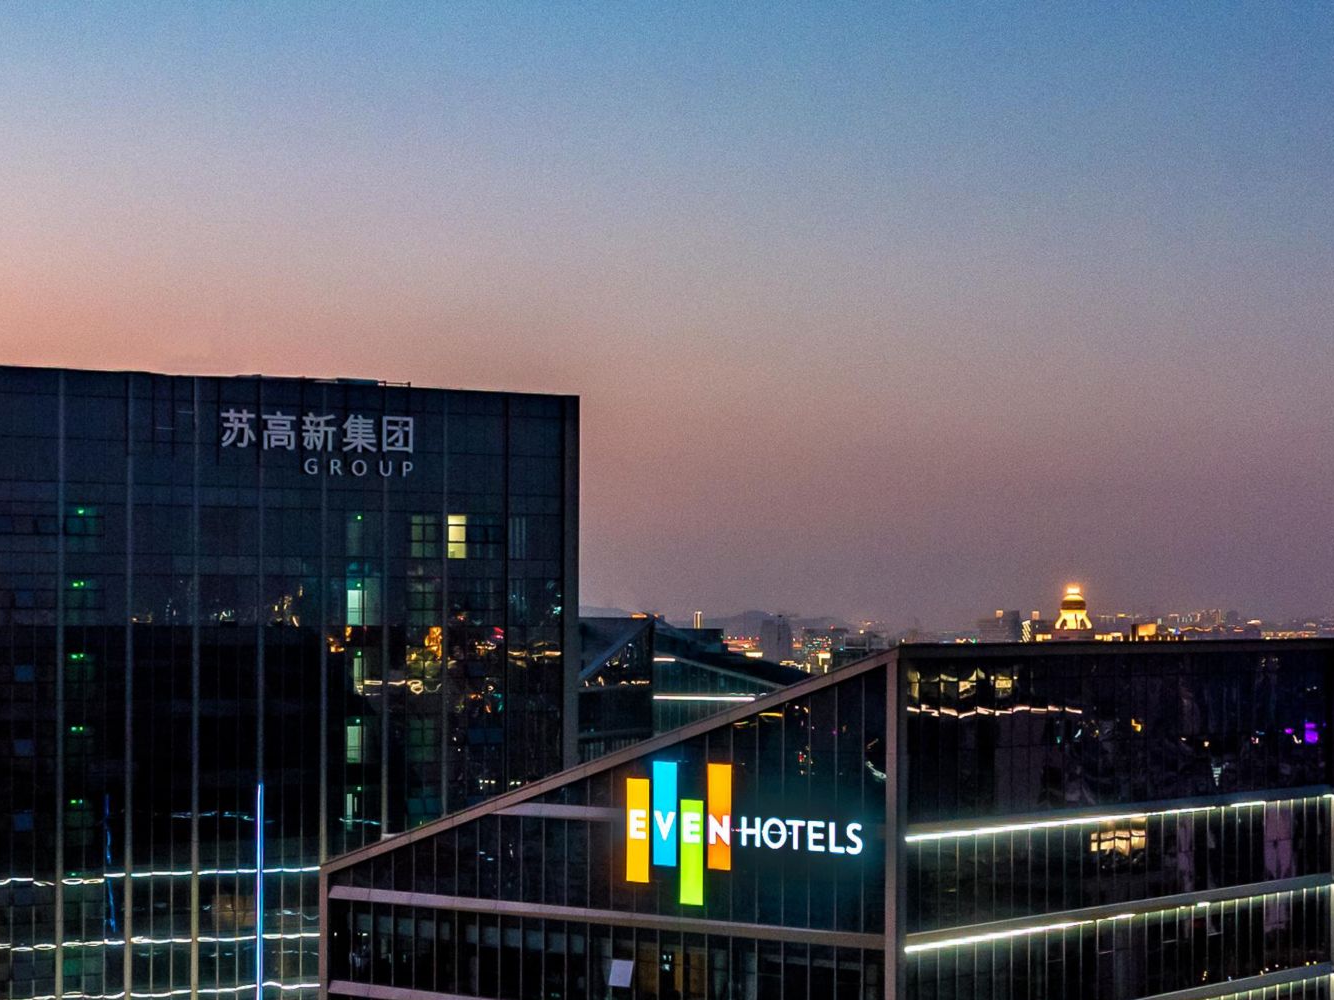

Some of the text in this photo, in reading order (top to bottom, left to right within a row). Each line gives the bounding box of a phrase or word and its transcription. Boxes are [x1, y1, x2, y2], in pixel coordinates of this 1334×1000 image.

[220, 407, 414, 454] 苏高新集团
[304, 457, 414, 477] GROUP
[628, 808, 864, 856] EVEN HOTELS
